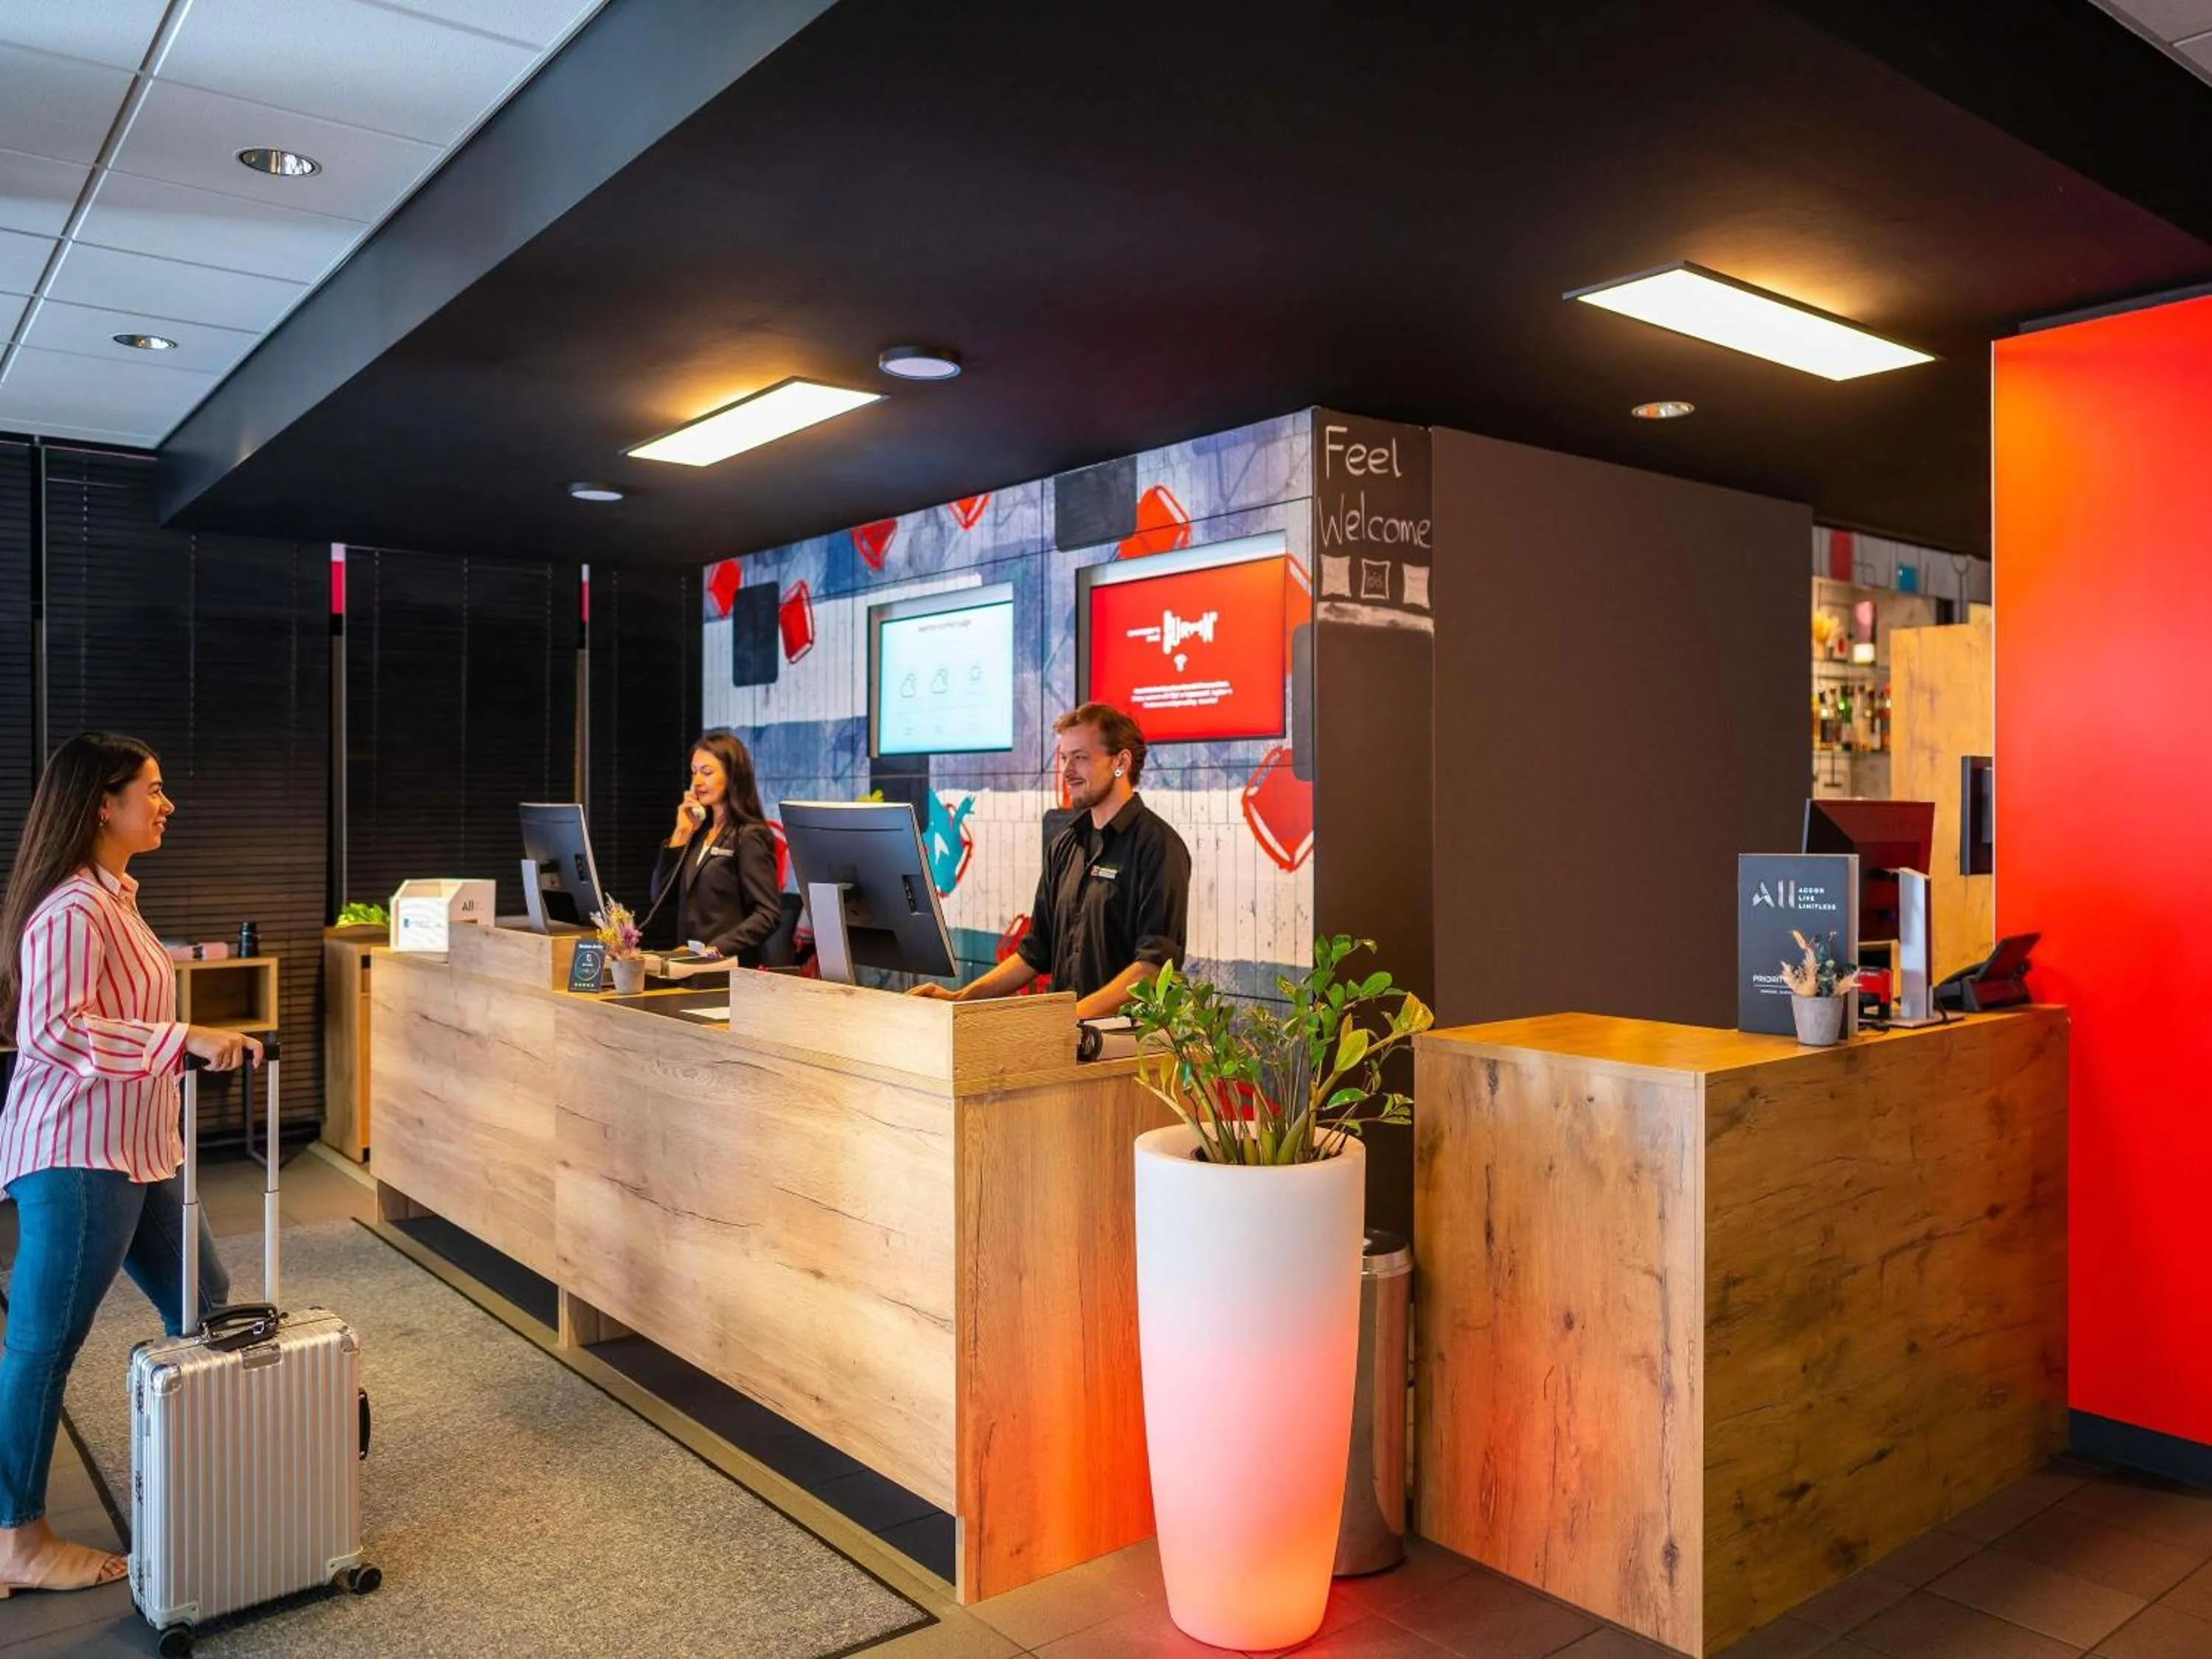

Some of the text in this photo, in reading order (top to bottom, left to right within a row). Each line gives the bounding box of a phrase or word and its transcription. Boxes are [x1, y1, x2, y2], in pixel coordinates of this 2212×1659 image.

[1325, 425, 1402, 480] Feel
[1318, 490, 1432, 548] Welcome
[1752, 879, 1795, 909] All
[1753, 975, 1784, 983] PRIORIT
